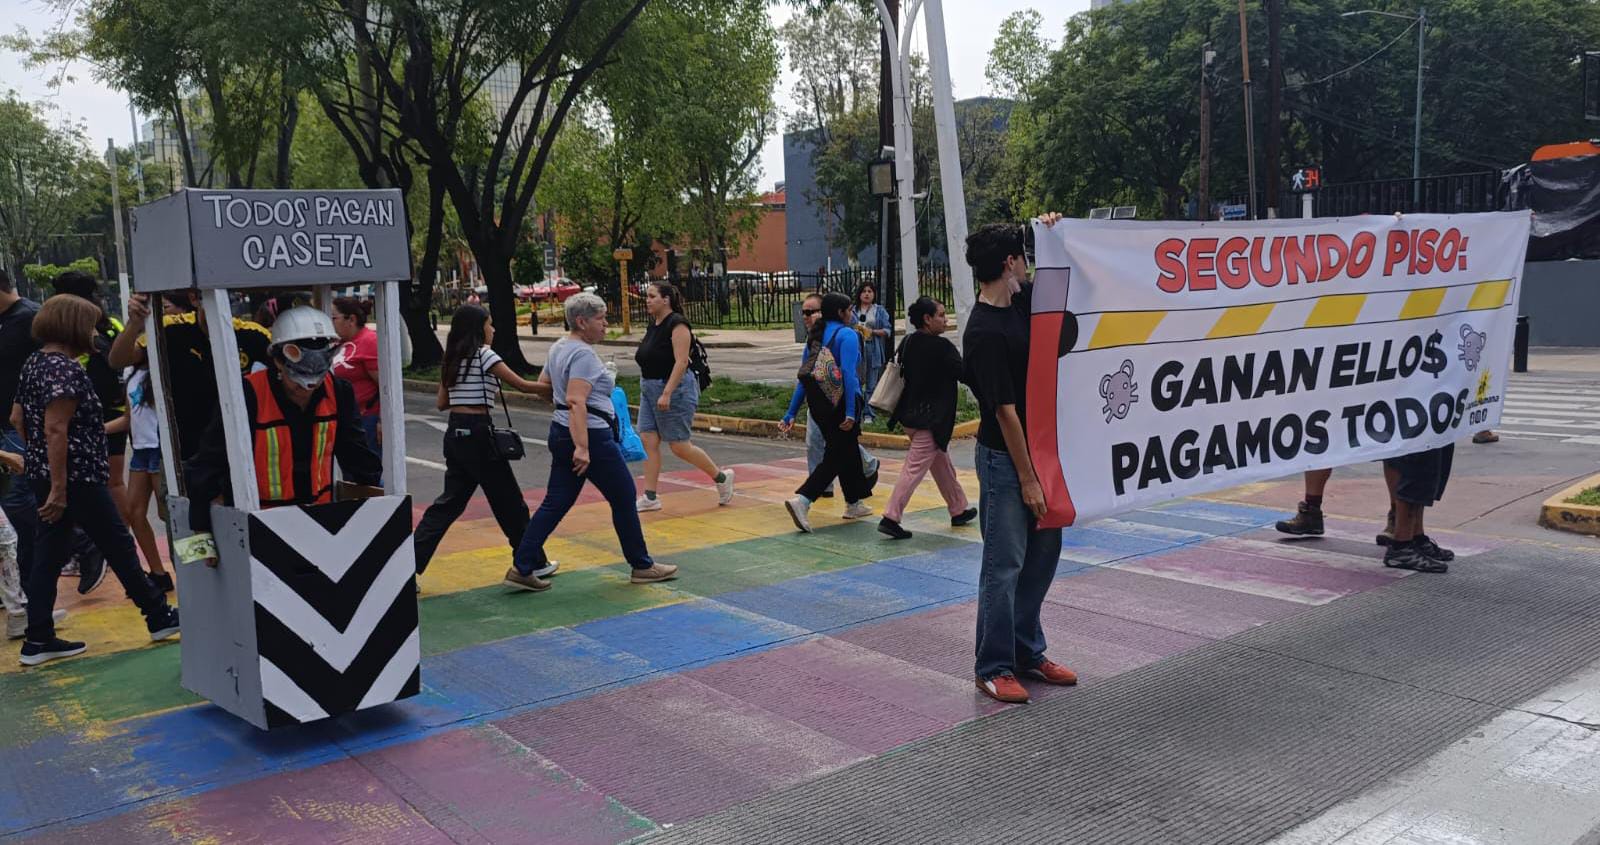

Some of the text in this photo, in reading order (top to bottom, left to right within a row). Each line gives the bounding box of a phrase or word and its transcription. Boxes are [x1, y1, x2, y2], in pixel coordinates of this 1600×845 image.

[1304, 168, 1319, 189] 34
[202, 195, 395, 228] TODOS PAGAN
[241, 230, 373, 270] CASETA
[544, 249, 553, 267] E
[1154, 227, 1470, 293] SEGUNDO PISO:
[1151, 329, 1448, 412] GANAN ELLO$
[1111, 388, 1470, 496] PAGAMOS TODOS
